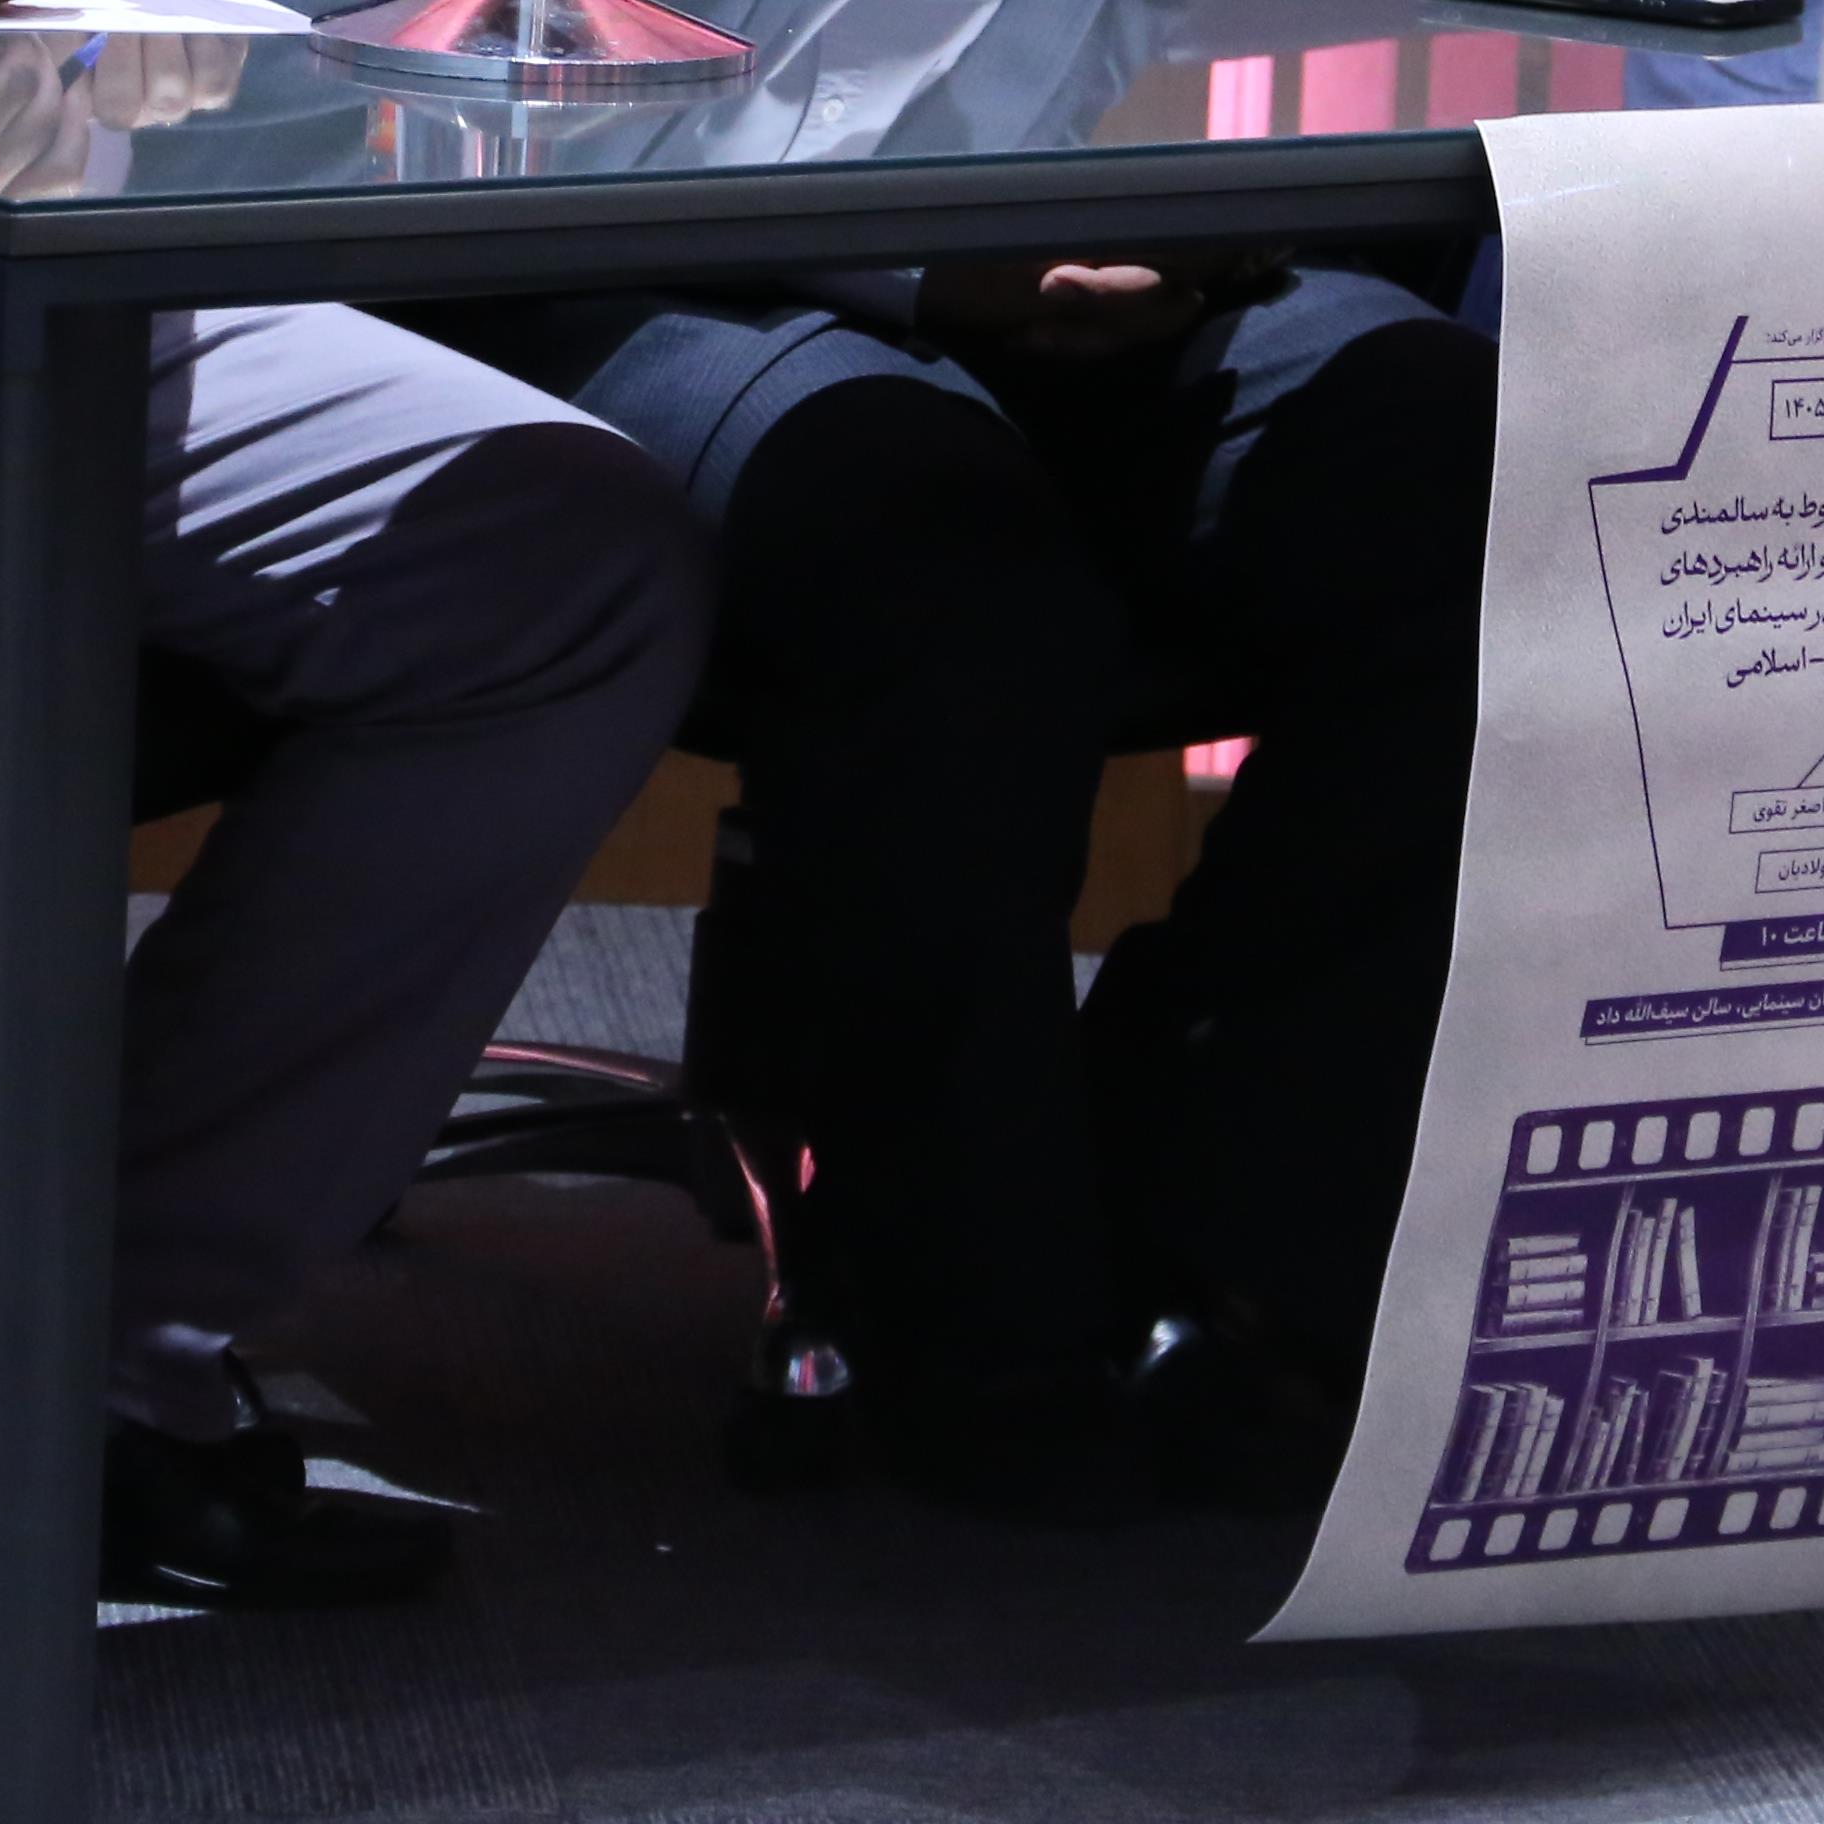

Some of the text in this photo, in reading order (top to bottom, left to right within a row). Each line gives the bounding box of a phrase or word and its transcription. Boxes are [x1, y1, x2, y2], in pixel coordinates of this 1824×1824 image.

[1661, 495, 1769, 535] سالمندی
[1772, 495, 1795, 525] به
[1660, 544, 1774, 586] راهبردهای
[1777, 541, 1816, 581] ارائه
[1662, 599, 1713, 639] ایران
[1715, 597, 1808, 634] سینمای
[1753, 799, 1787, 823] تقوی
[1760, 927, 1777, 946] ۱۰
[1595, 1006, 1620, 1026] داد
[1691, 997, 1733, 1023] سالن
